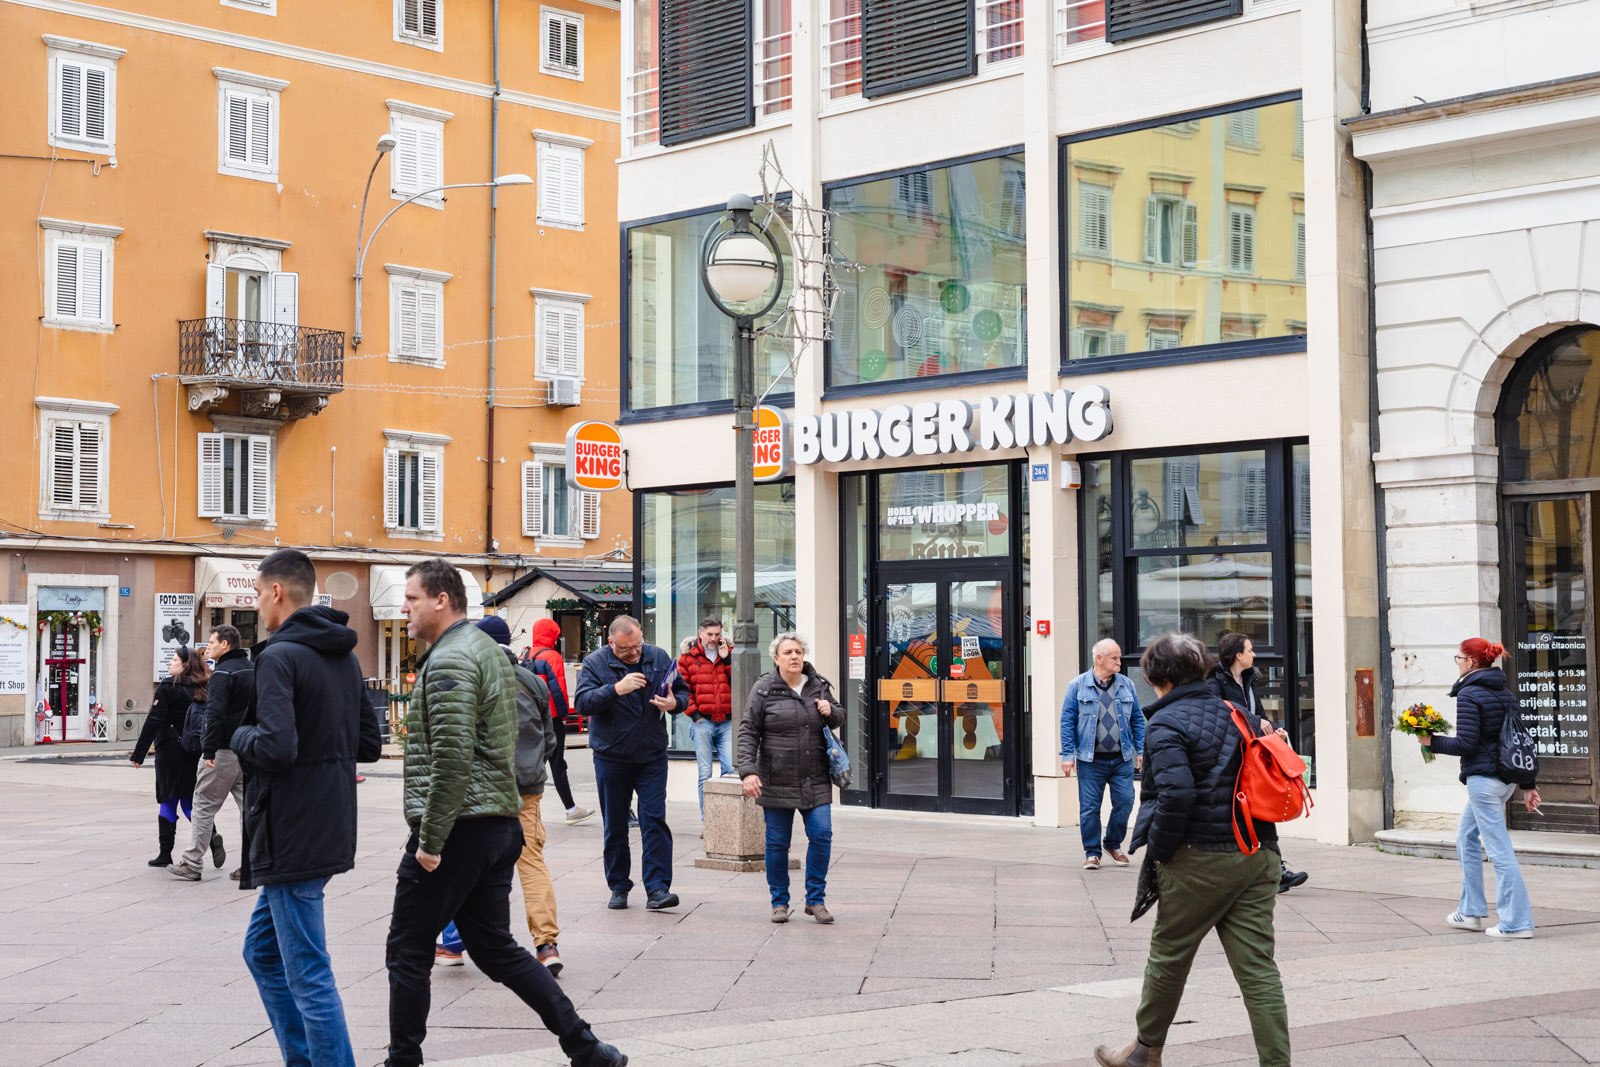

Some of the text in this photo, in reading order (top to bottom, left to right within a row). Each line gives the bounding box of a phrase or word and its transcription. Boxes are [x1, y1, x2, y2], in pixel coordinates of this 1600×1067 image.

[794, 385, 1112, 465] BURGER KING
[753, 428, 781, 444] RGER
[576, 442, 621, 458] BURGER
[753, 443, 781, 464] ING
[576, 456, 621, 477] KING
[1034, 467, 1046, 475] 24A
[887, 502, 999, 524] HOME WHOPPER
[887, 515, 914, 525] OF THE
[160, 595, 177, 605] FOTO
[235, 595, 258, 605] FOT
[1518, 641, 1586, 650] Narodna čitaonica
[1518, 670, 1555, 679] ponedjeljak
[8, 681, 25, 691] Shop
[1519, 681, 1586, 692] utorak 8-19.30
[1519, 697, 1587, 710] srijeda 8-19.30
[1520, 713, 1588, 722] četvrtak 8-18.00
[1526, 724, 1558, 738] etak
[1560, 730, 1588, 738] 8-19.30
[1536, 741, 1568, 754] bota
